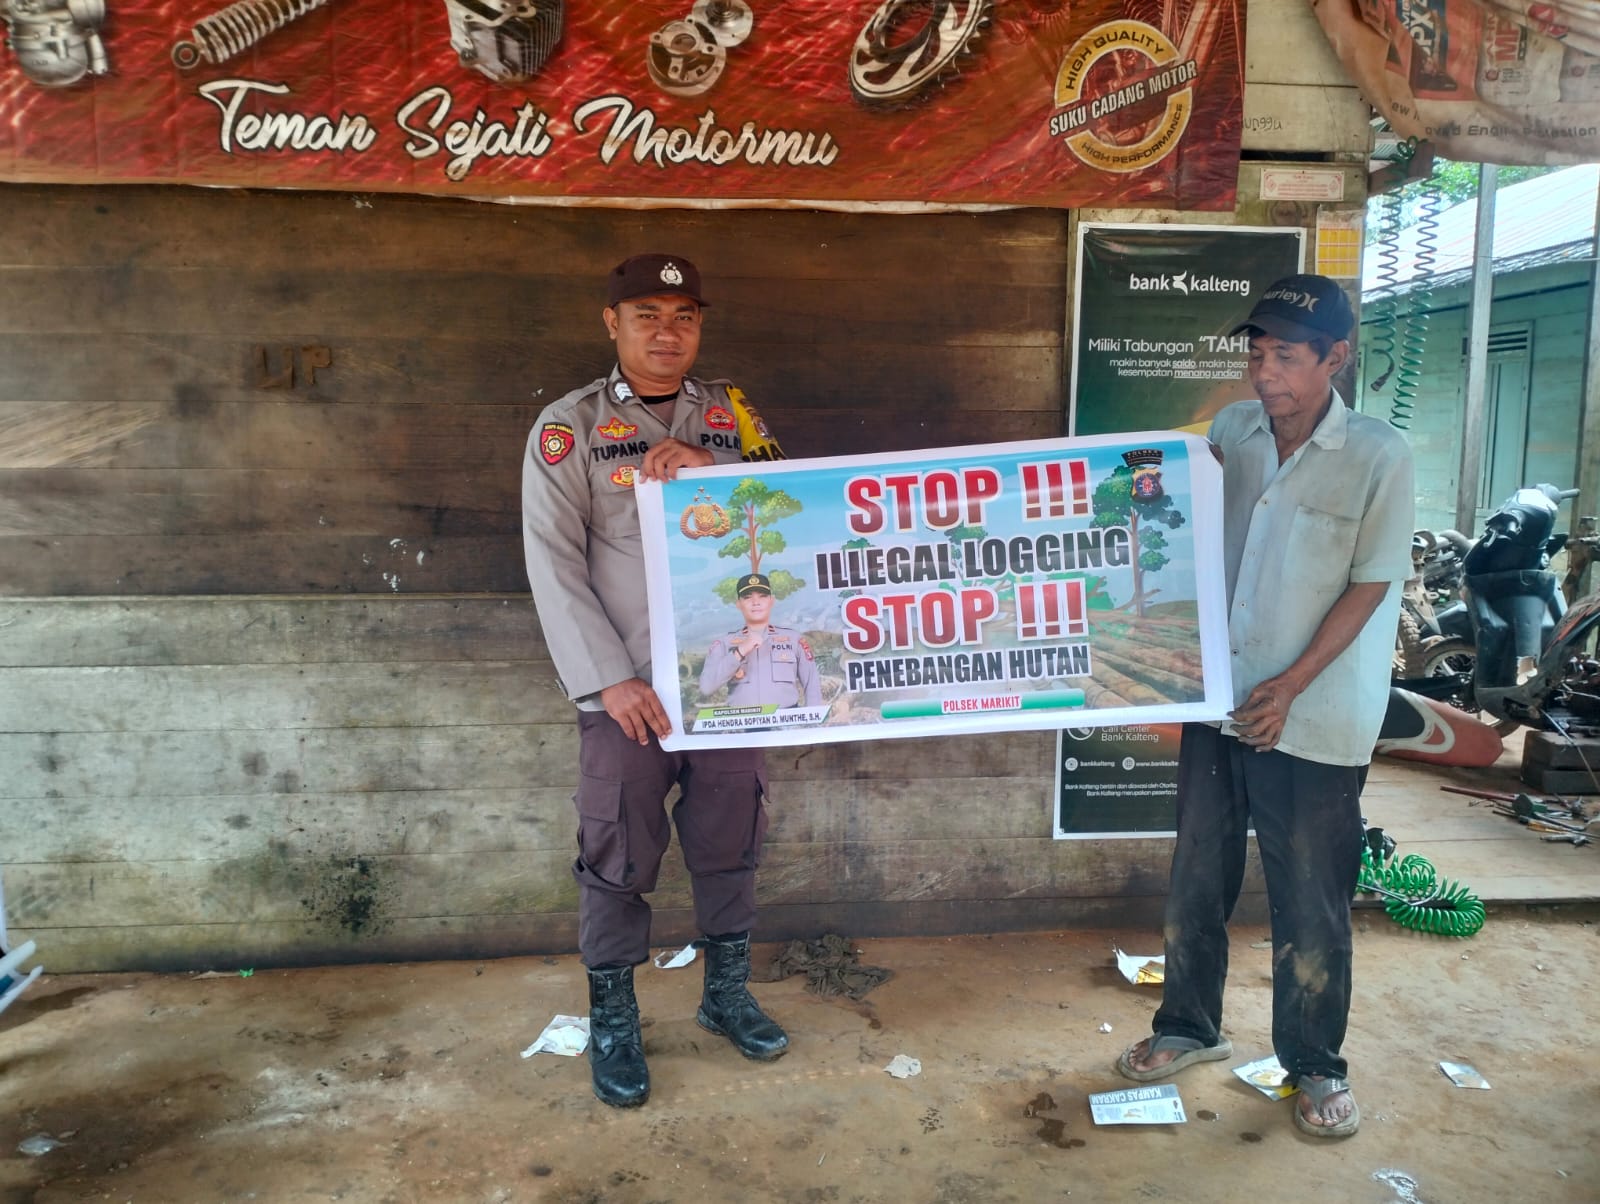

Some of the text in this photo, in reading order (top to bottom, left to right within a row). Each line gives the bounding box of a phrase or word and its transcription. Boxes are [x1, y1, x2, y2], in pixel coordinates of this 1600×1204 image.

[1066, 31, 1164, 90] HIGH QUALITY
[1050, 60, 1198, 136] SUKU CADANG MOTOR
[199, 78, 839, 183] Teman Sejati Motormu
[1081, 103, 1183, 163] HIGH PERFORMANCE
[1243, 116, 1283, 131] unggu
[1130, 273, 1250, 296] bank kalteng
[1088, 338, 1121, 352] Miliki
[1123, 338, 1194, 355] Tabungan
[1109, 358, 1137, 367] makin
[1138, 358, 1172, 369] banyak
[1199, 359, 1226, 368] makin
[1118, 368, 1242, 379] kesempatan menang undian
[592, 441, 649, 462] TUPANG
[847, 461, 1090, 533] STOP !!!
[816, 527, 1130, 590] ILLEGAL LOGGING
[845, 580, 1085, 652] STOP !!!
[849, 646, 1090, 691] PENEBANGAN HUTAN
[943, 695, 1020, 712] POLSEK MARIKIT
[717, 717, 743, 728] HENDRA
[780, 713, 808, 725] MUNTHE,
[1101, 733, 1159, 743] Bank Kalteng
[1091, 1087, 1162, 1105] KAMPAS CAKRAM
